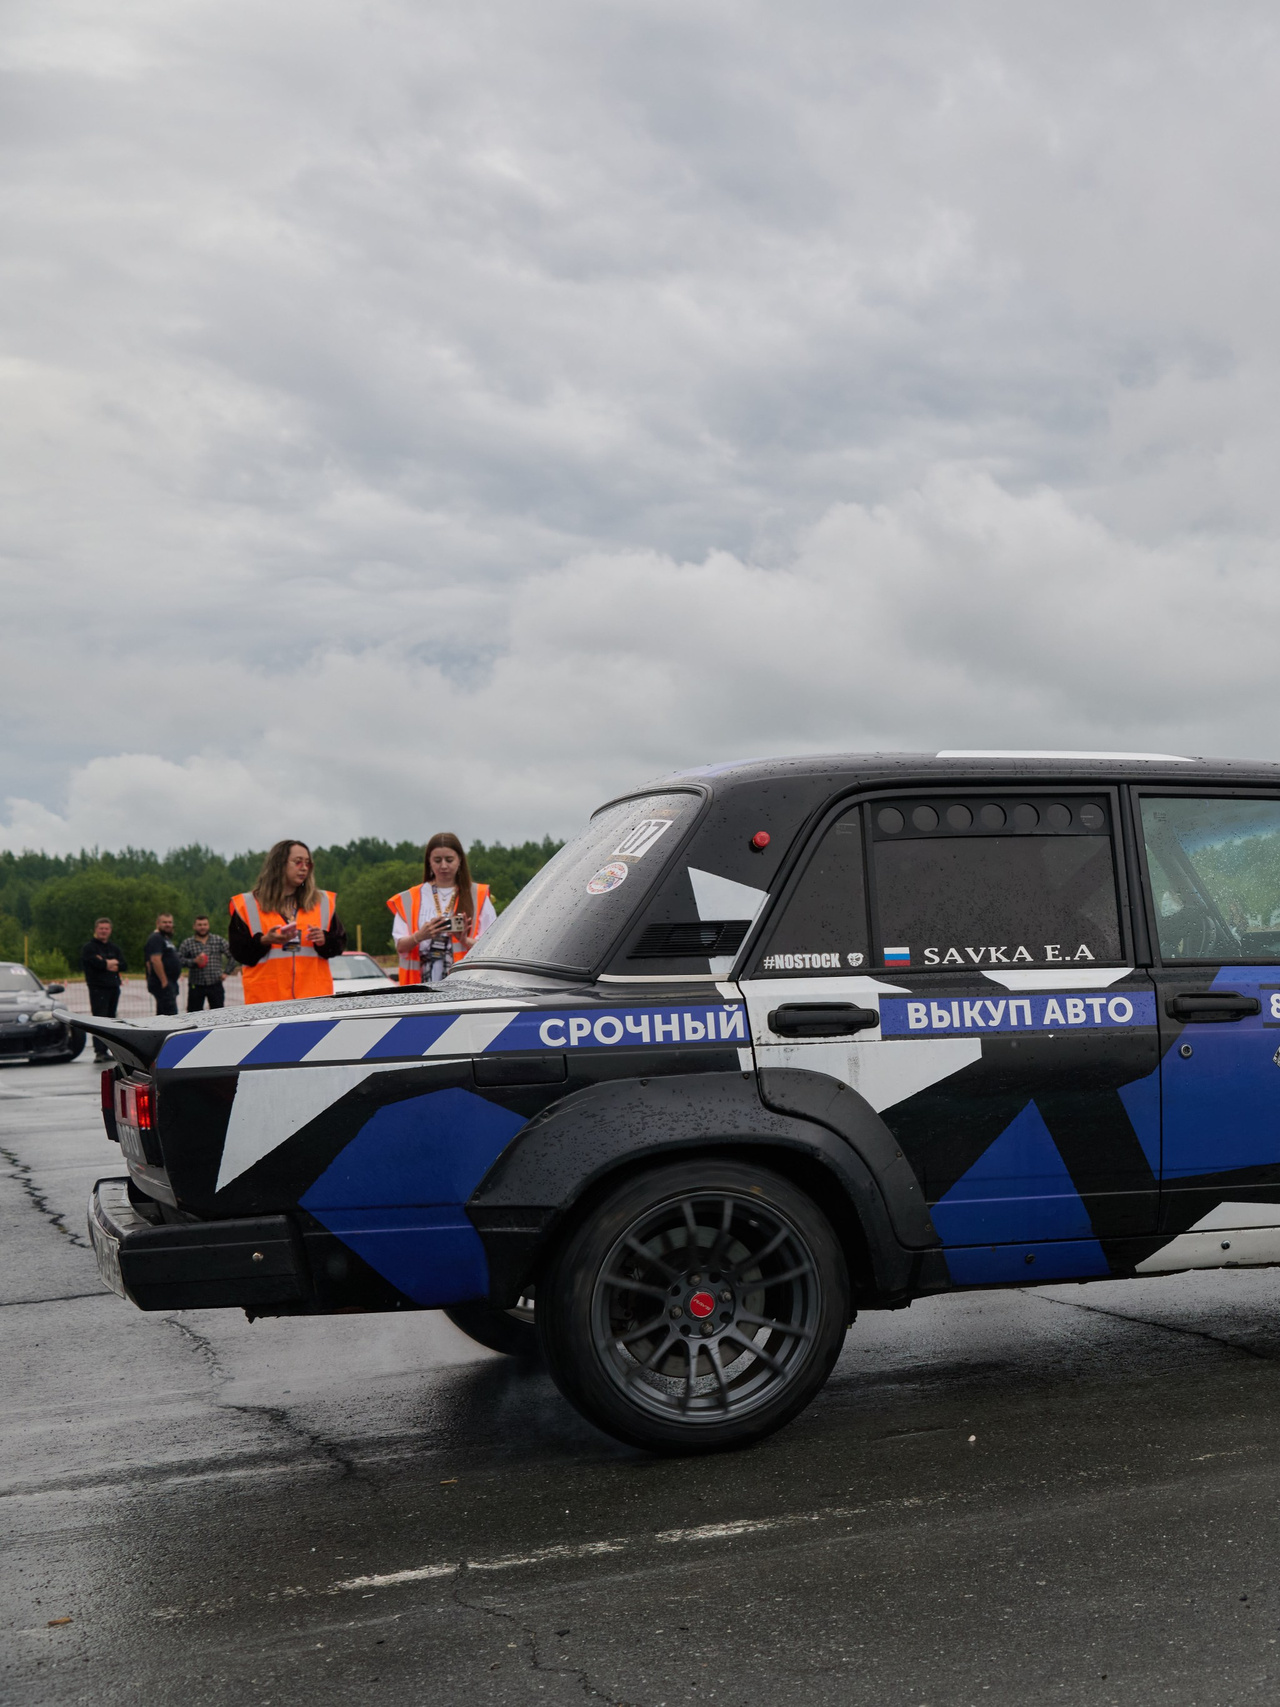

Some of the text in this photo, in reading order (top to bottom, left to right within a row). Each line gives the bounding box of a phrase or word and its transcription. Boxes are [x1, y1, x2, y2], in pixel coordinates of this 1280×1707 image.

[618, 820, 668, 854] 07
[763, 953, 841, 969] #NOSTOCK
[923, 944, 1095, 965] SAVKA E.A
[539, 1004, 745, 1047] СРОЧНЫЙ
[907, 997, 1134, 1030] ВЫКУП АВТО
